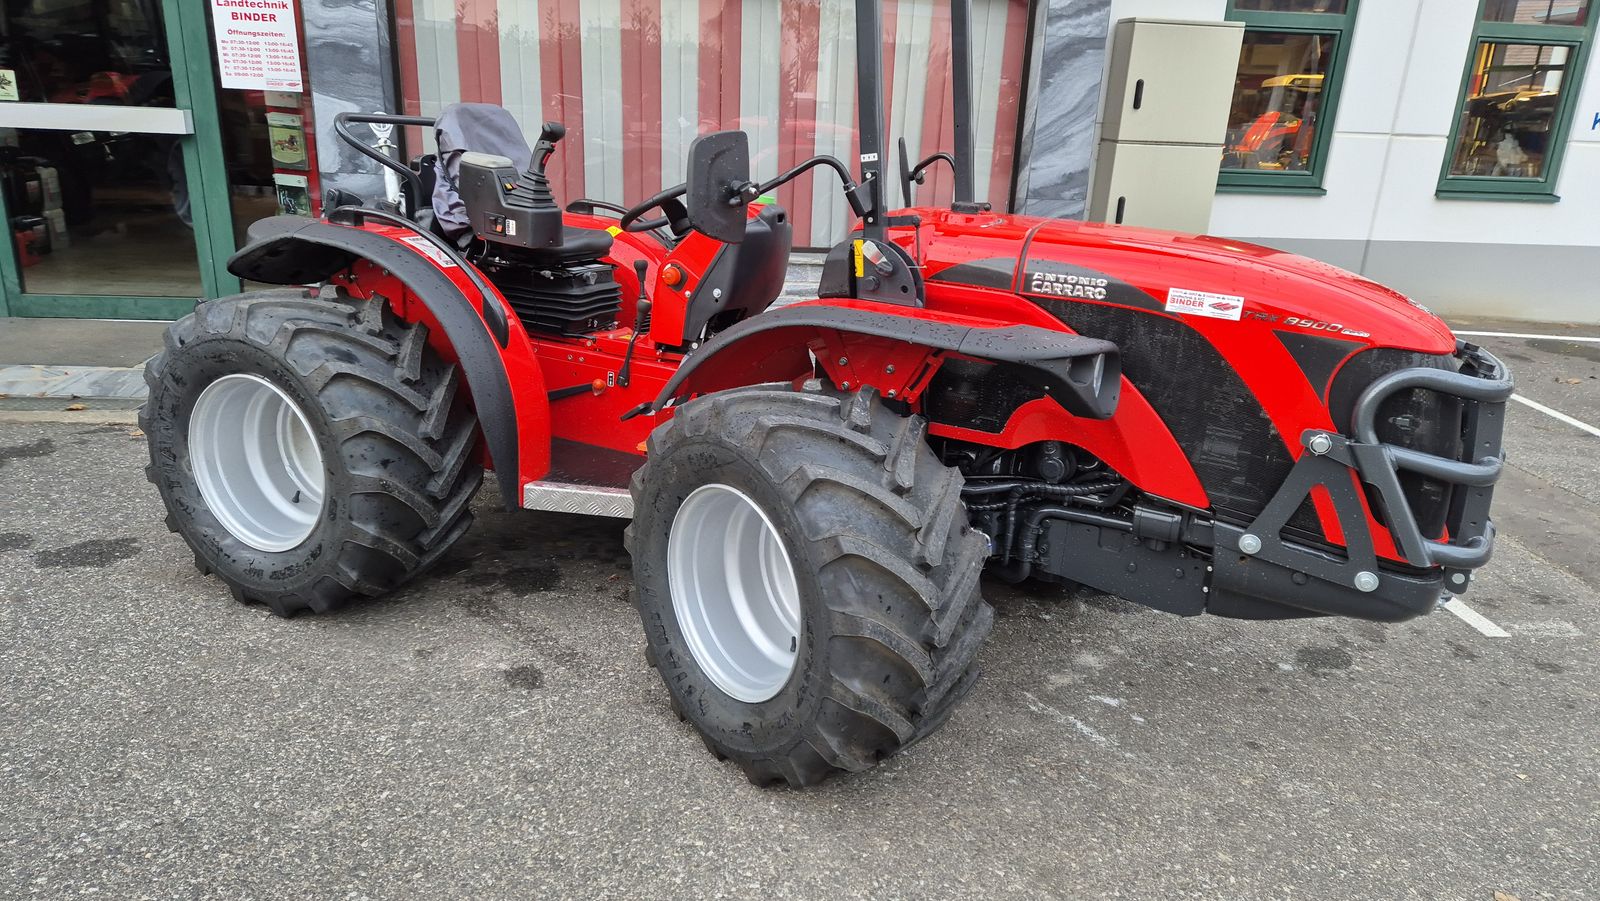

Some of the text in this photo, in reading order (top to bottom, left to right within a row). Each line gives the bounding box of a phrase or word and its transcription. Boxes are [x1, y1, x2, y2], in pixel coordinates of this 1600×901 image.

[231, 12, 277, 22] BINDER
[1033, 271, 1108, 287] ANTONIO
[1032, 280, 1107, 299] CARRARO
[1169, 297, 1205, 308] BINDER
[1283, 316, 1343, 332] 8900
